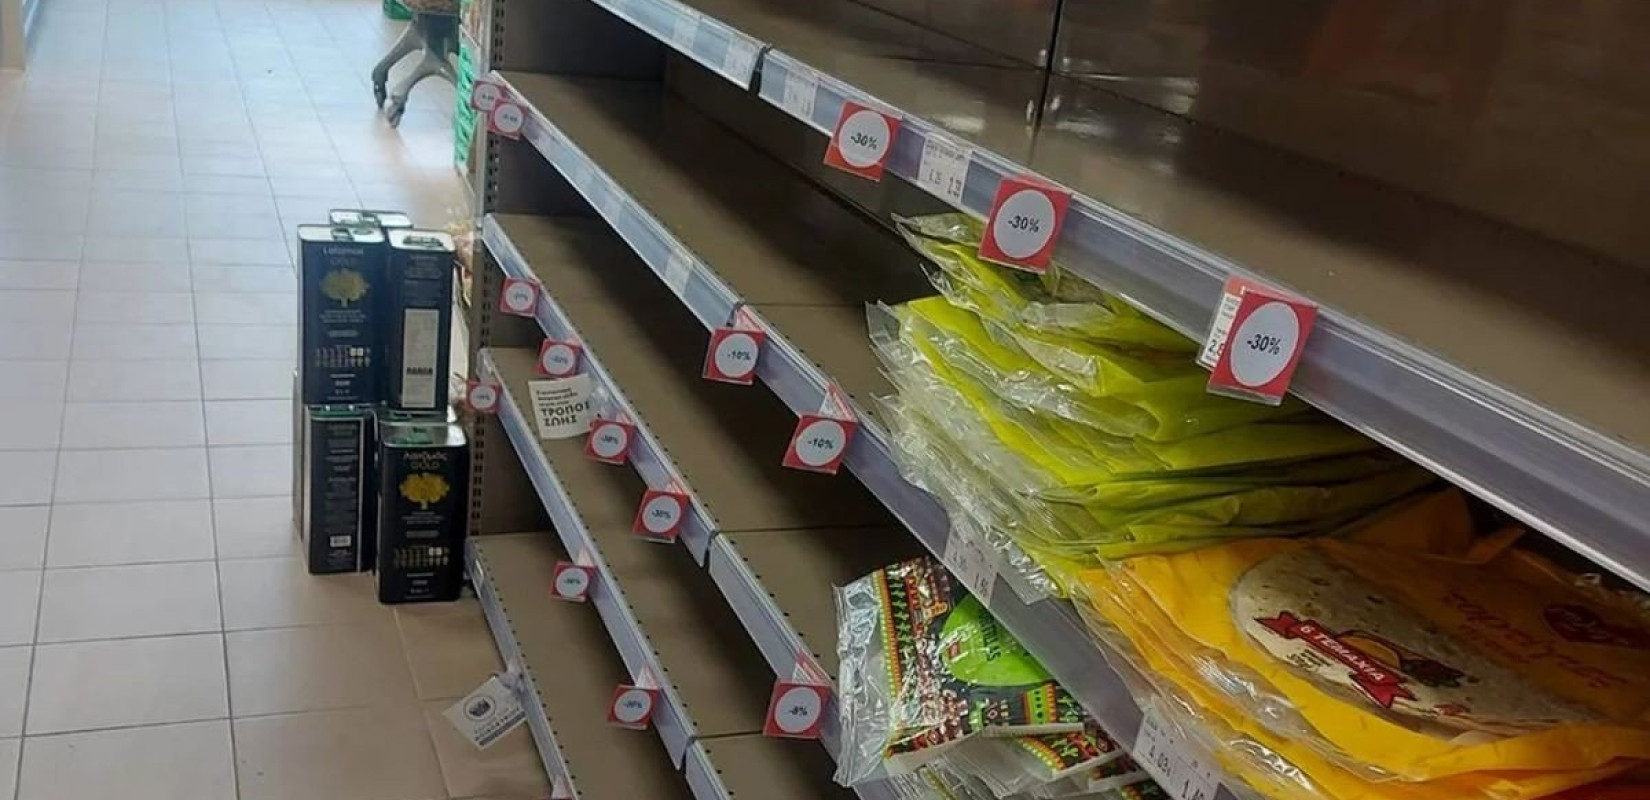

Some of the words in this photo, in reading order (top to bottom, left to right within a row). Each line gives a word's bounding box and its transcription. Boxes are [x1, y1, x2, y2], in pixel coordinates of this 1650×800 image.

[849, 132, 878, 150] -30%
[1006, 215, 1040, 233] -30%
[1245, 333, 1281, 356] -30%
[726, 350, 752, 361] -10%
[541, 400, 590, 416] ΤΡΟΠΟΣ
[806, 437, 834, 450] -10%
[1300, 625, 1315, 634] 6
[1314, 633, 1386, 681] ΤΕΜΑΧΙΑ
